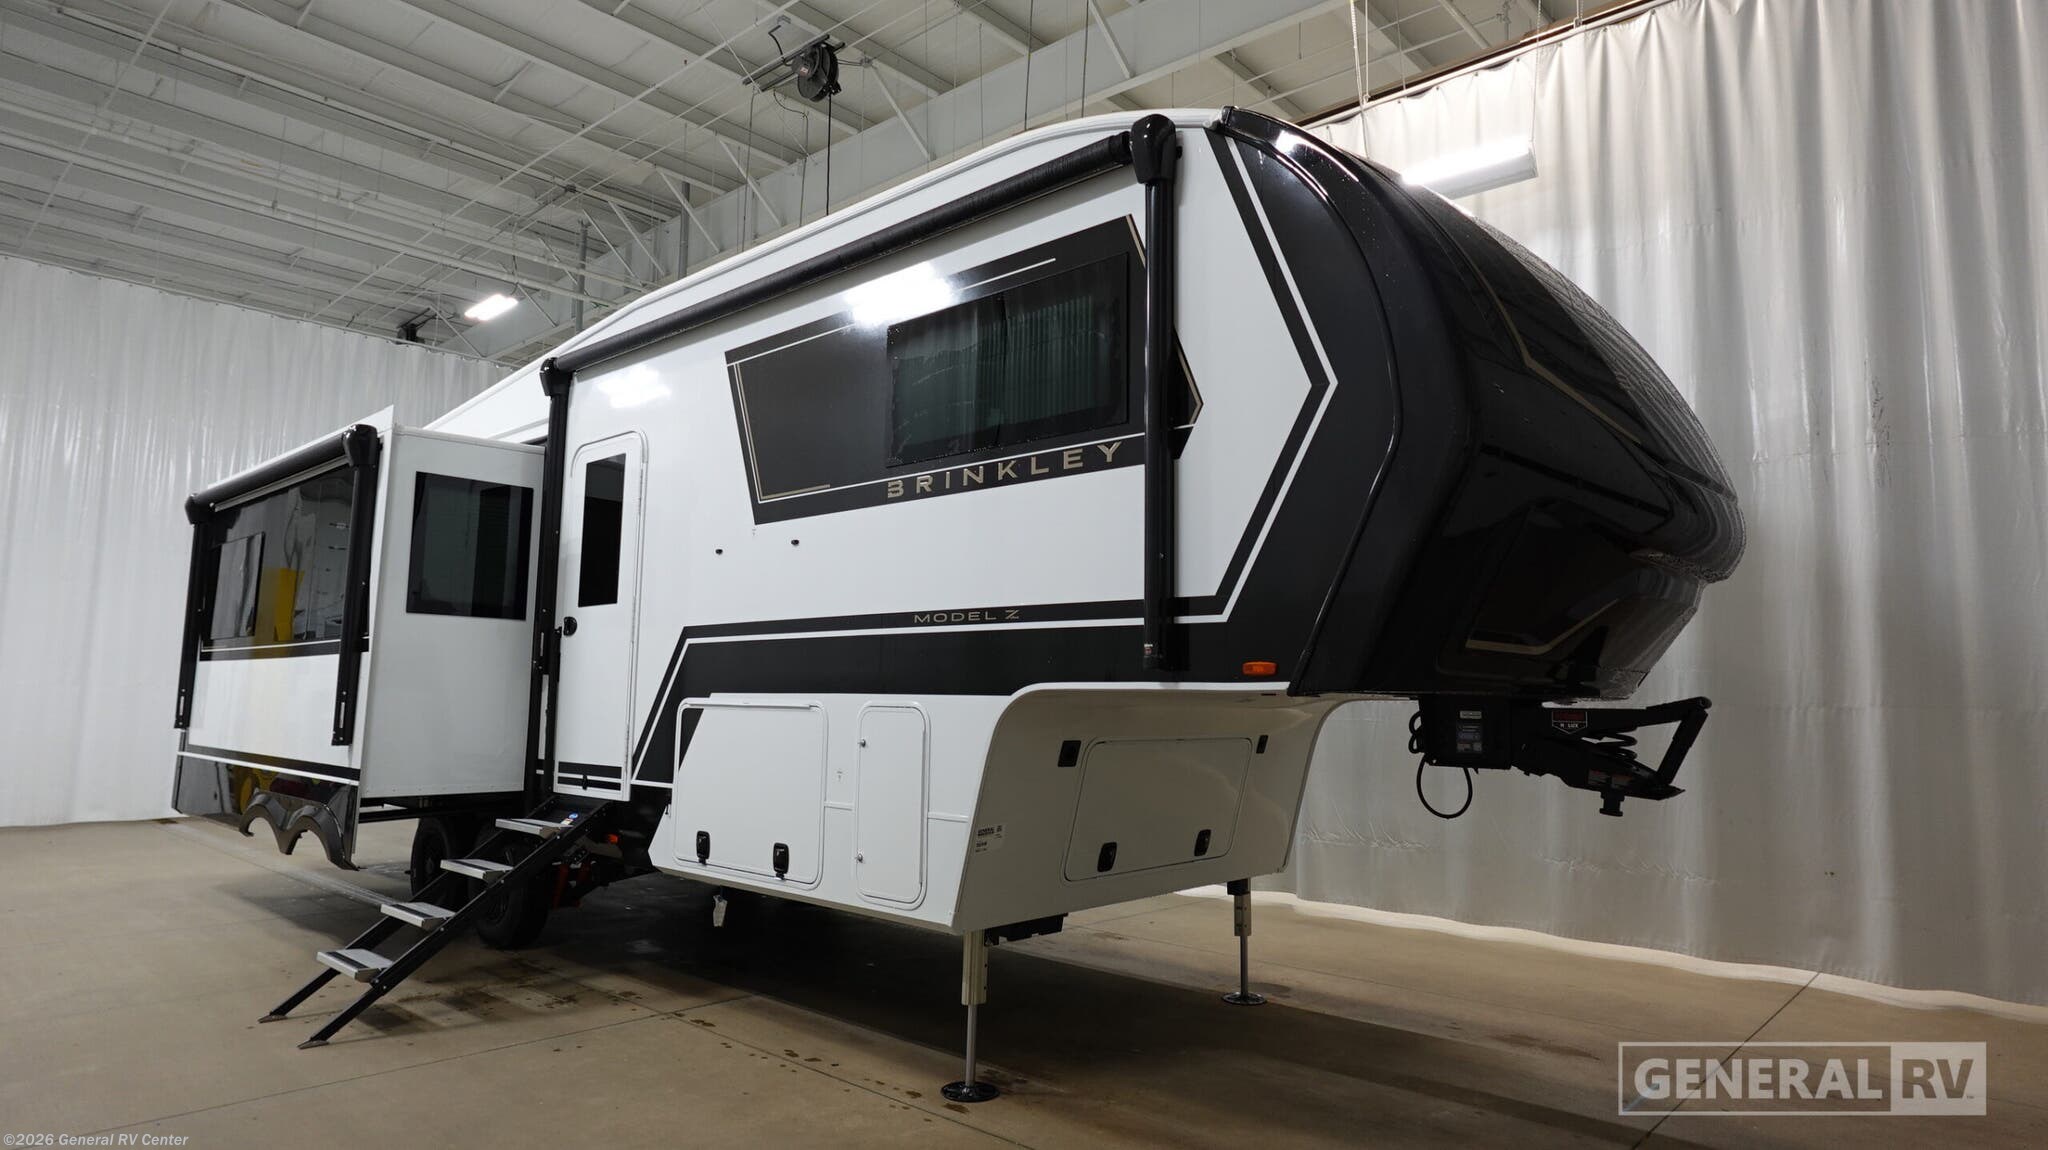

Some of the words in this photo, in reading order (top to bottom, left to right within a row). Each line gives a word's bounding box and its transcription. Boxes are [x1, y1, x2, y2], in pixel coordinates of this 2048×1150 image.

[887, 441, 1122, 499] BRINKLEY
[914, 611, 997, 624] MODEL
[1005, 609, 1020, 620] Z
